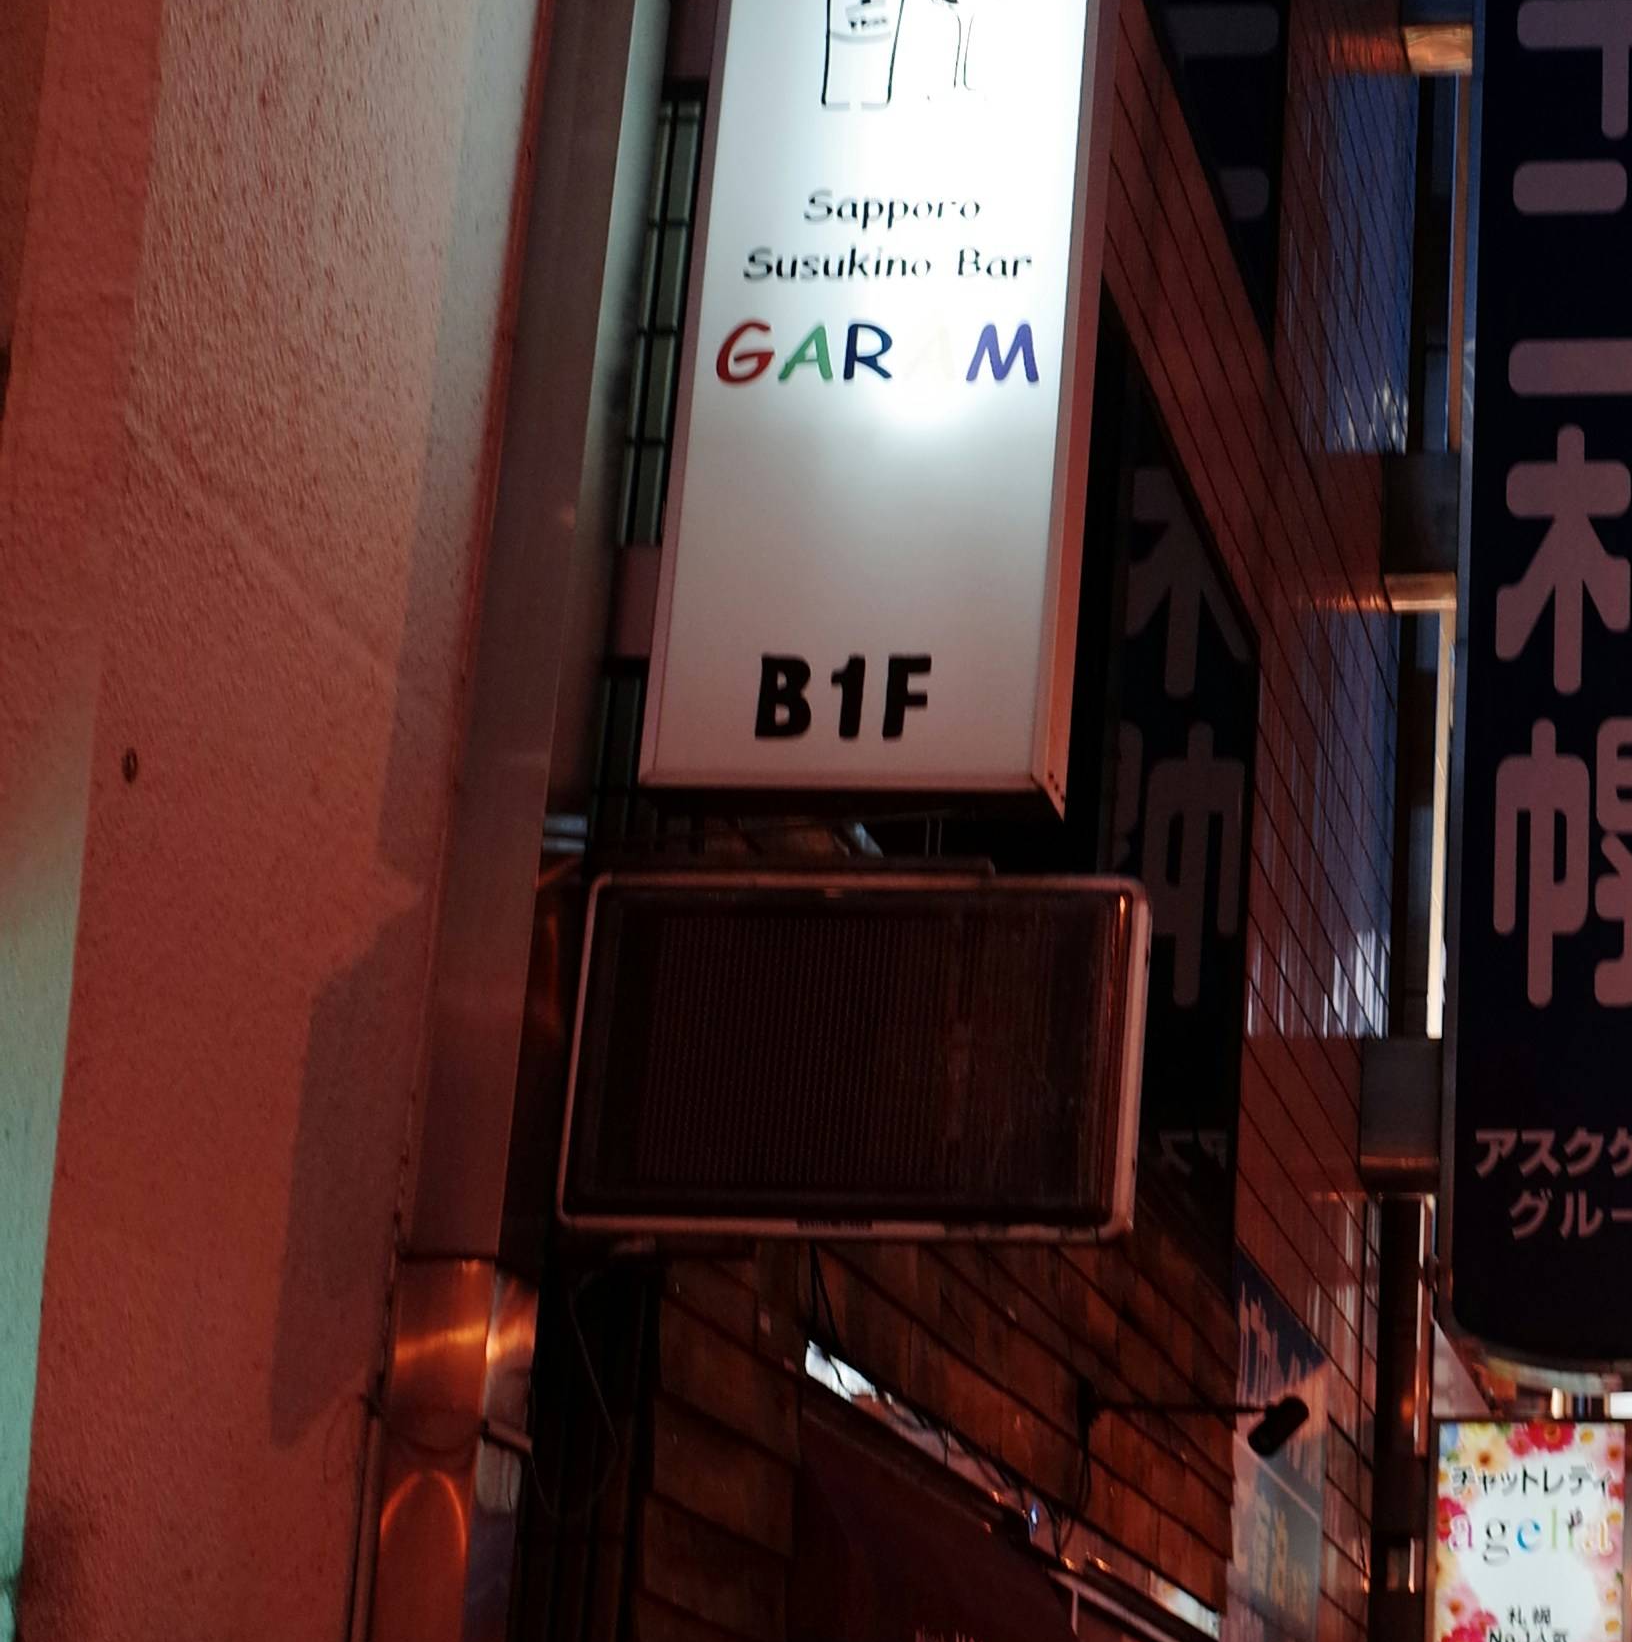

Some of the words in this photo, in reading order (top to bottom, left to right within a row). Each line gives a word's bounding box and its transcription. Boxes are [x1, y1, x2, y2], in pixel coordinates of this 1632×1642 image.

[802, 189, 981, 230] Sapporo
[743, 245, 932, 281] Susukino
[957, 246, 1033, 279] Bar
[715, 319, 1040, 386] GARM
[755, 653, 932, 739] B1F
[1451, 1462, 1616, 1497] チャットレディ
[1508, 1605, 1552, 1626] 札幌
